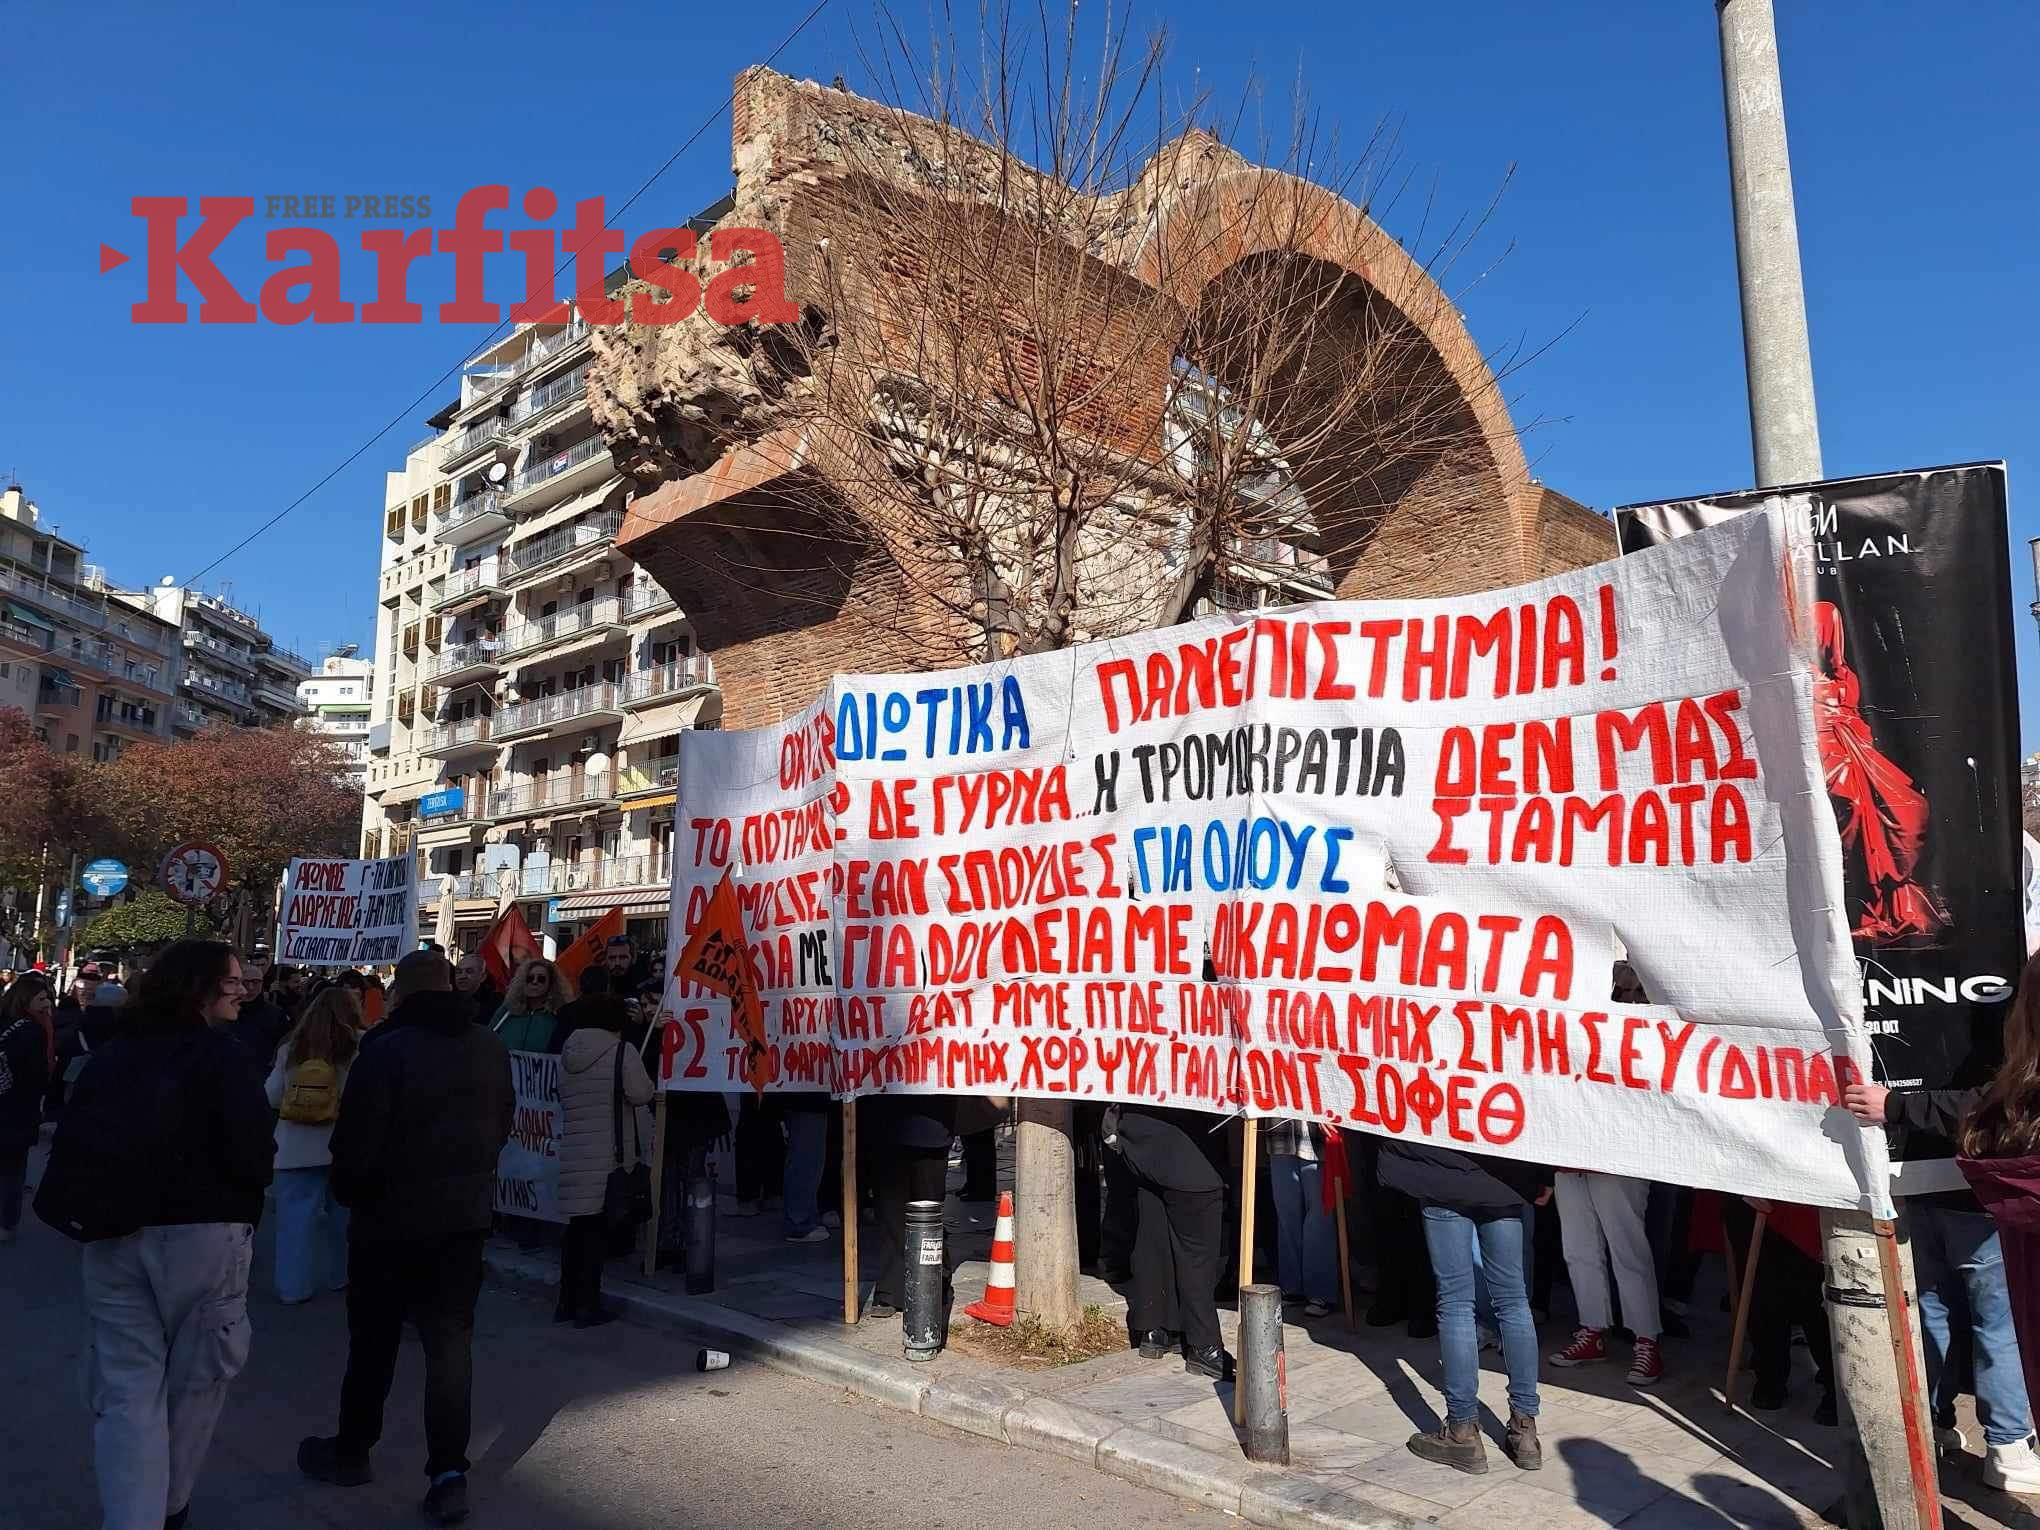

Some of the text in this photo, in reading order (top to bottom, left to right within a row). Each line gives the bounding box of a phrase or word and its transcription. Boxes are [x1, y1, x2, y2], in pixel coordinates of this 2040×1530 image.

[835, 675, 1031, 762] ΔΙΩΤΙΚΑ
[691, 818, 732, 867] ΤΟ
[868, 778, 920, 840] ΔΕ
[1436, 715, 1574, 799] ΔΕΝ
[1600, 690, 1759, 792] ΜΑΣ
[1134, 822, 1192, 894] ΓΙΑ
[1427, 784, 1752, 867] ΣΤΑΜΑΤΑ
[799, 929, 833, 986] ΜΕ
[843, 923, 917, 989] ΓΙΑ
[1123, 904, 1192, 975] ΜΕ
[1862, 975, 2014, 1007] NING
[1338, 1054, 1526, 1145] ΣΟΦΕΘ
